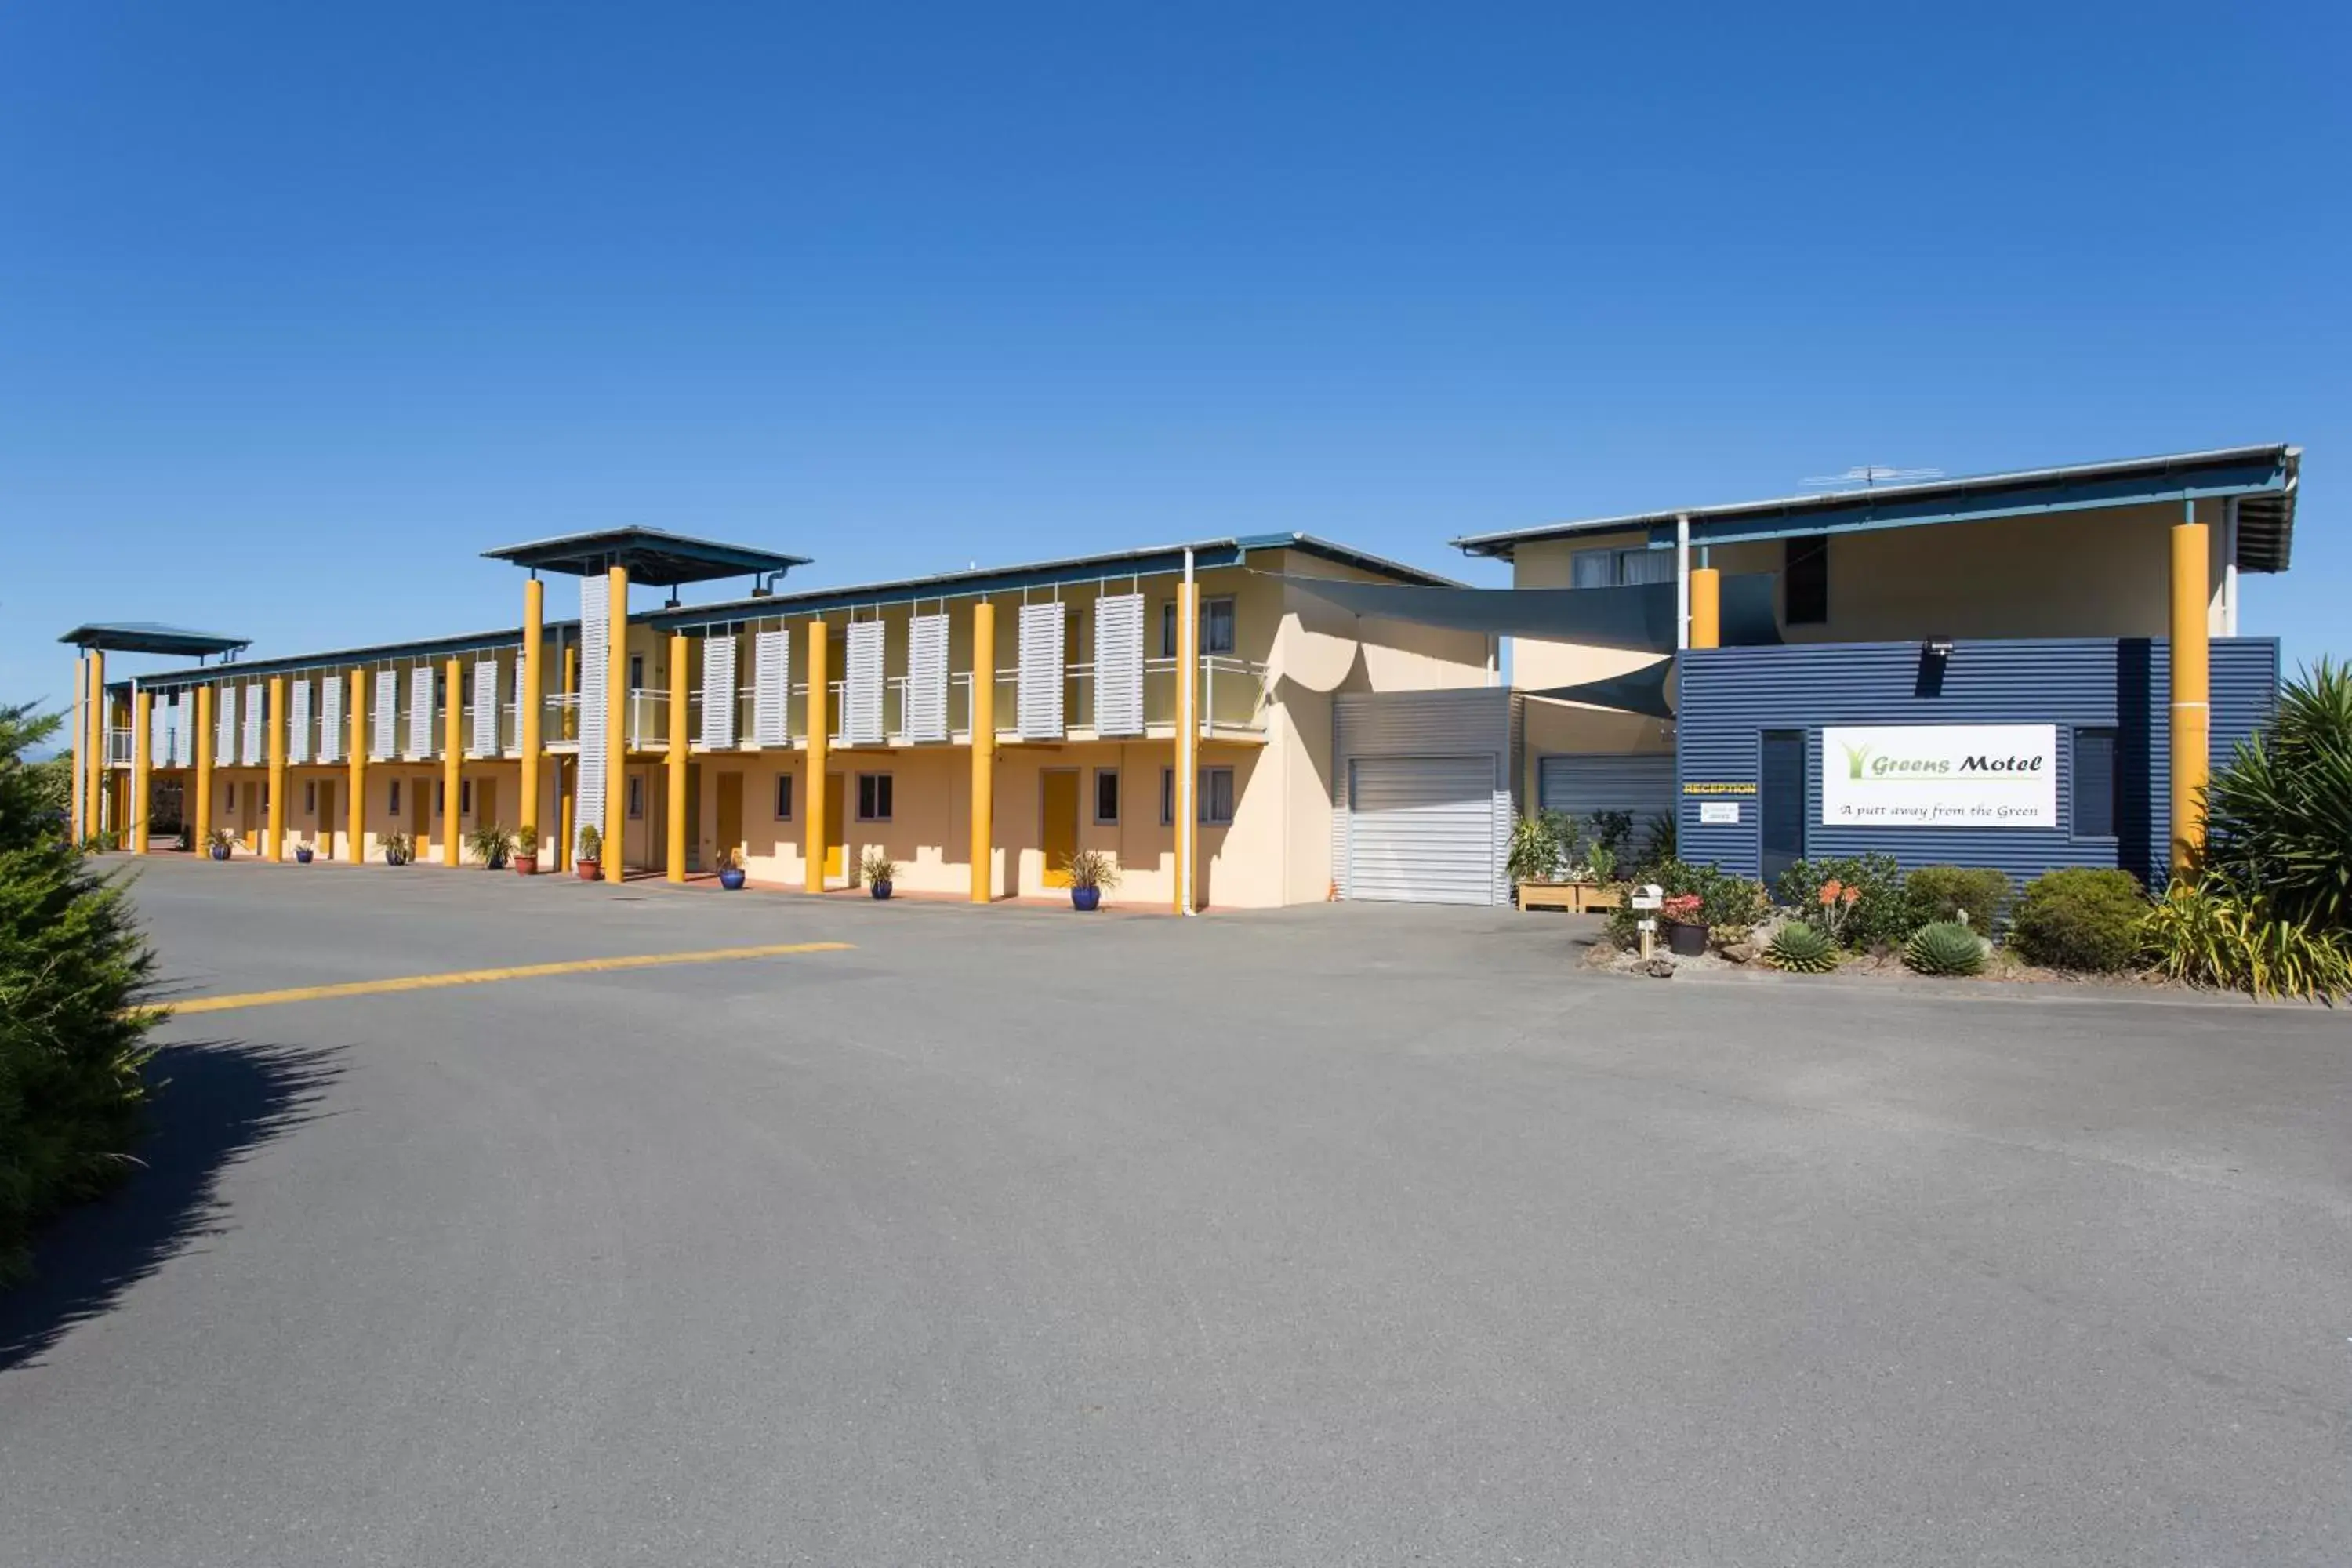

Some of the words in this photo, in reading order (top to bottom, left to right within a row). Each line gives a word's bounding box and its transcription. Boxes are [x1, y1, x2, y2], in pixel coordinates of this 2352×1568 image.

[1872, 756, 1950, 775] Greens
[1959, 755, 2042, 772] Motel
[1682, 782, 1757, 794] RECEPTION
[1840, 804, 1852, 815] A
[1857, 806, 1886, 819] putt
[1890, 808, 1929, 821] away
[1930, 804, 1965, 821] from
[1970, 804, 1993, 816] the
[1997, 805, 2038, 818] Green
